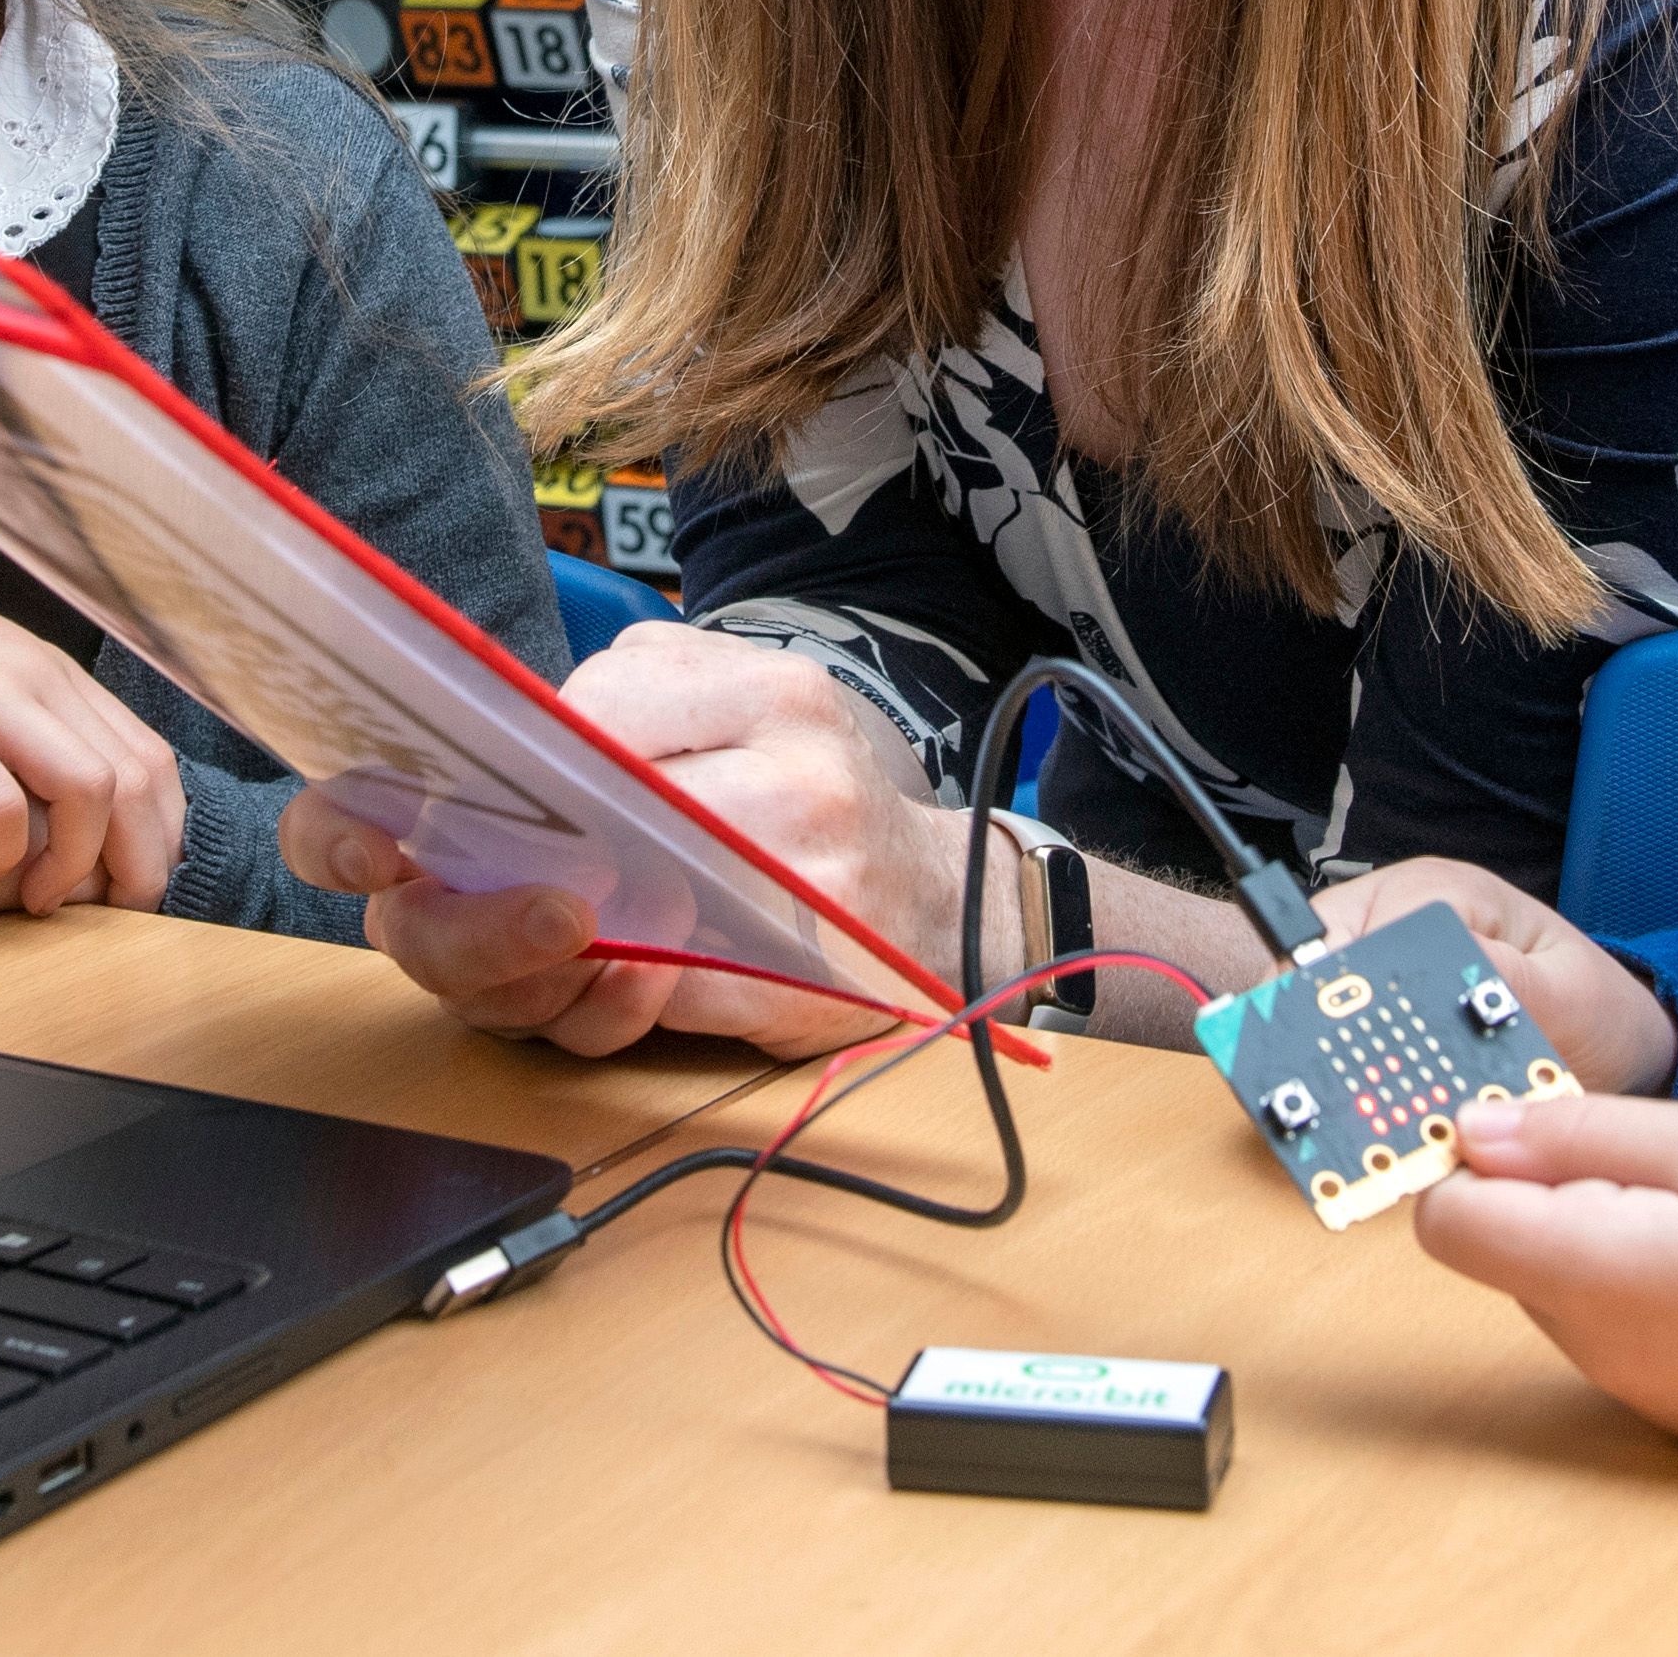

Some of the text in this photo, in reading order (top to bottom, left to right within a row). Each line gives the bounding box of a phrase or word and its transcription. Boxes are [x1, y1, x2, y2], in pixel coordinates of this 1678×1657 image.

[411, 22, 570, 75] 83 18
[530, 251, 586, 308] 18
[619, 505, 674, 556] 59
[944, 1379, 1168, 1406] micro:bit
